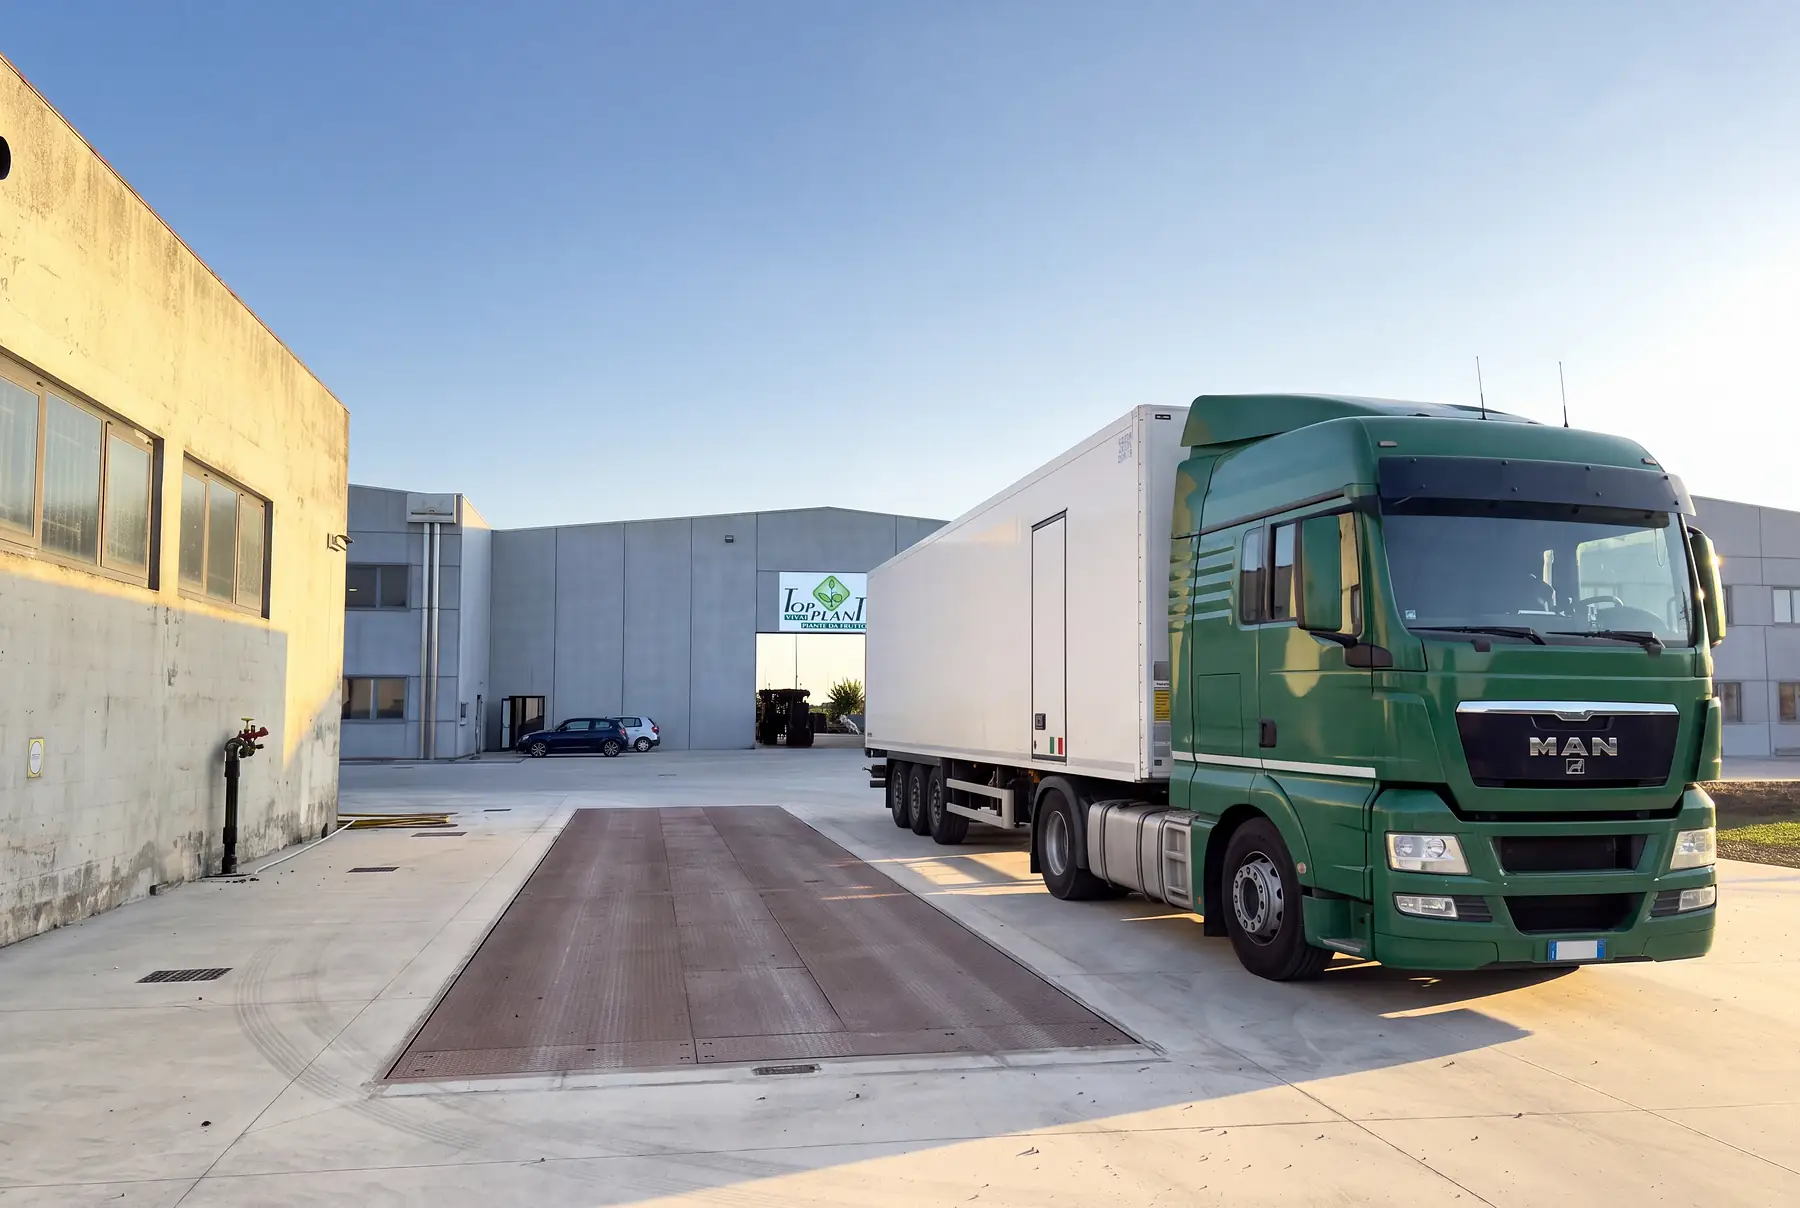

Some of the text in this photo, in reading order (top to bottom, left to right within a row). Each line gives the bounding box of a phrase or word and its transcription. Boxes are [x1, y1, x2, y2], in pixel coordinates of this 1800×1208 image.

[784, 588, 815, 613] TOP
[811, 597, 867, 621] PLANT
[1529, 736, 1618, 756] MAN
